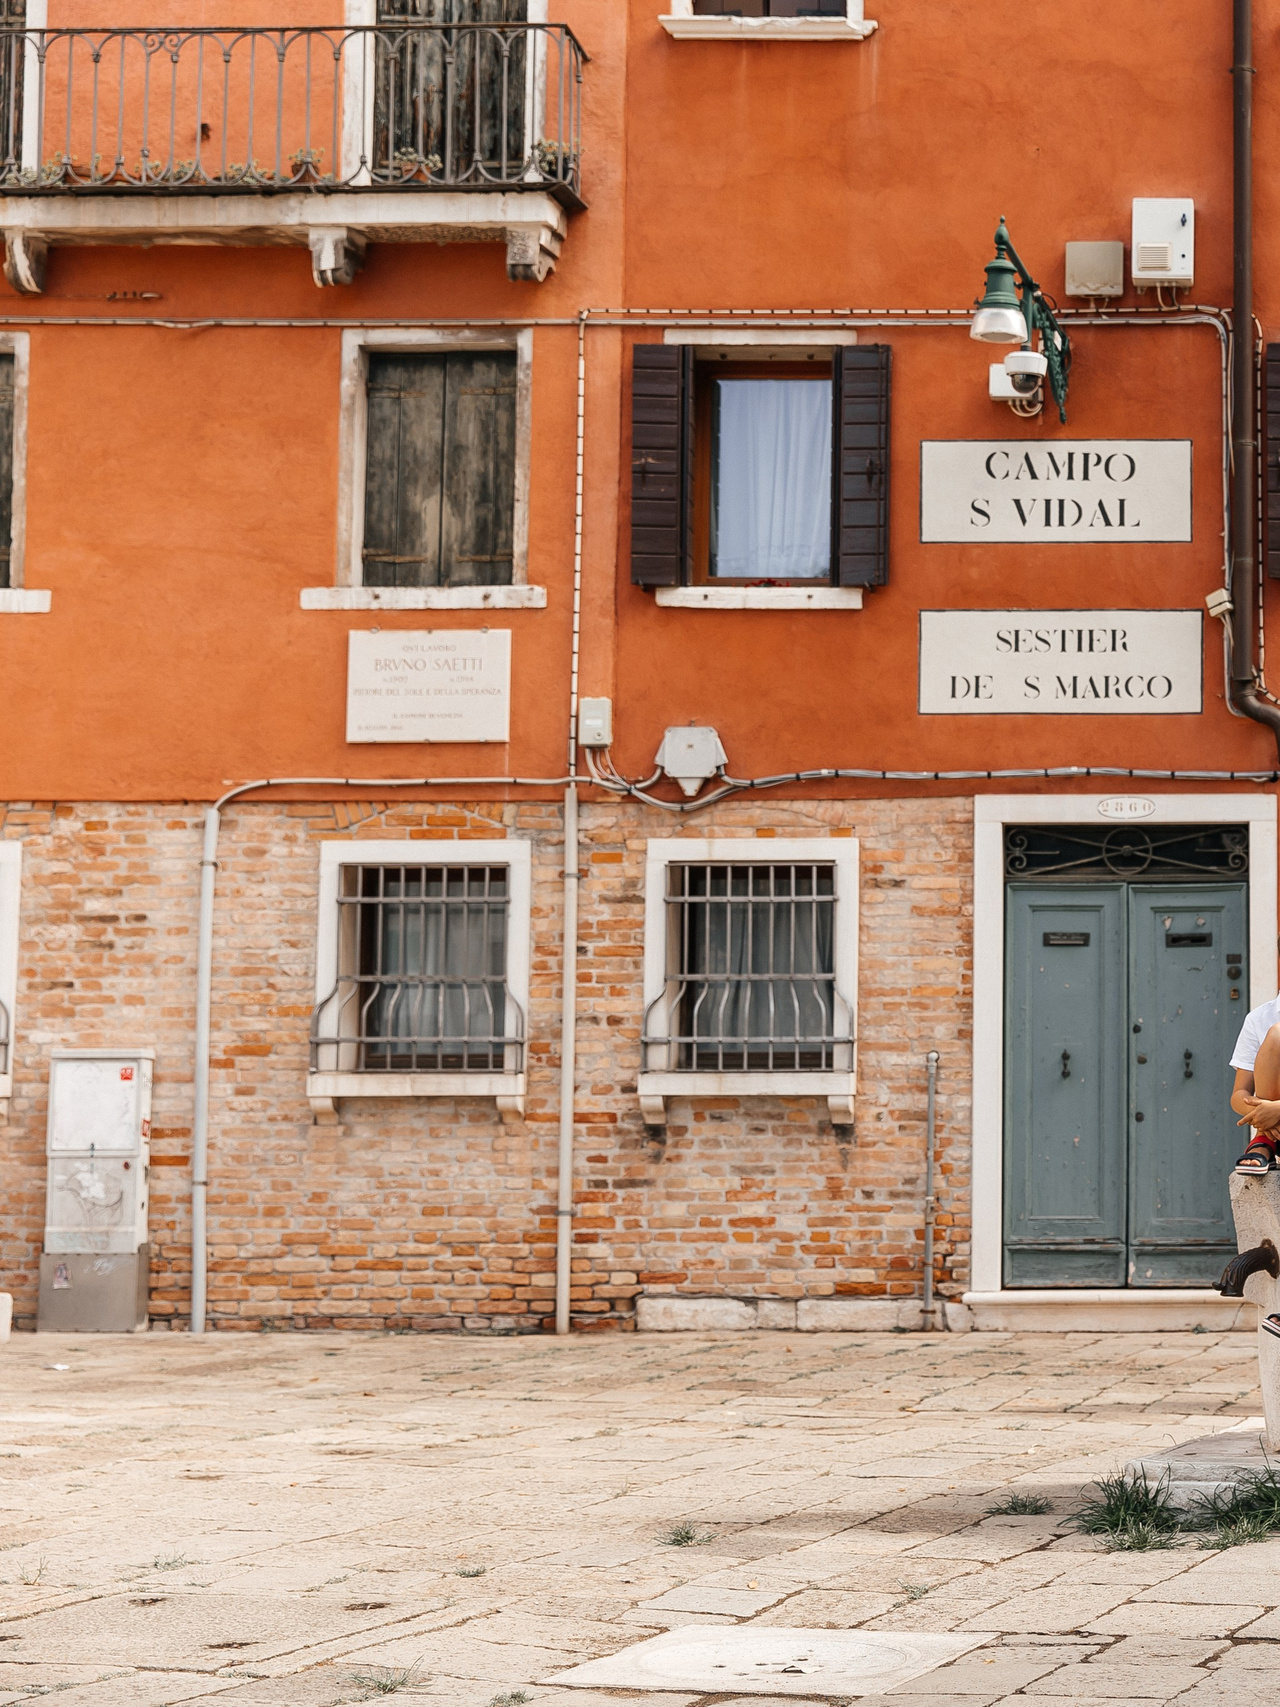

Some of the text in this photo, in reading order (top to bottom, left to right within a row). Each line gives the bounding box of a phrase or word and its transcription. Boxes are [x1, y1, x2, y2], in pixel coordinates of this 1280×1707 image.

[985, 451, 1137, 482] CAMPO
[970, 498, 1141, 528] S VIDAL
[996, 629, 1129, 653] SESTIER
[433, 658, 483, 671] SAETTI
[950, 675, 1173, 699] DE S MARCO
